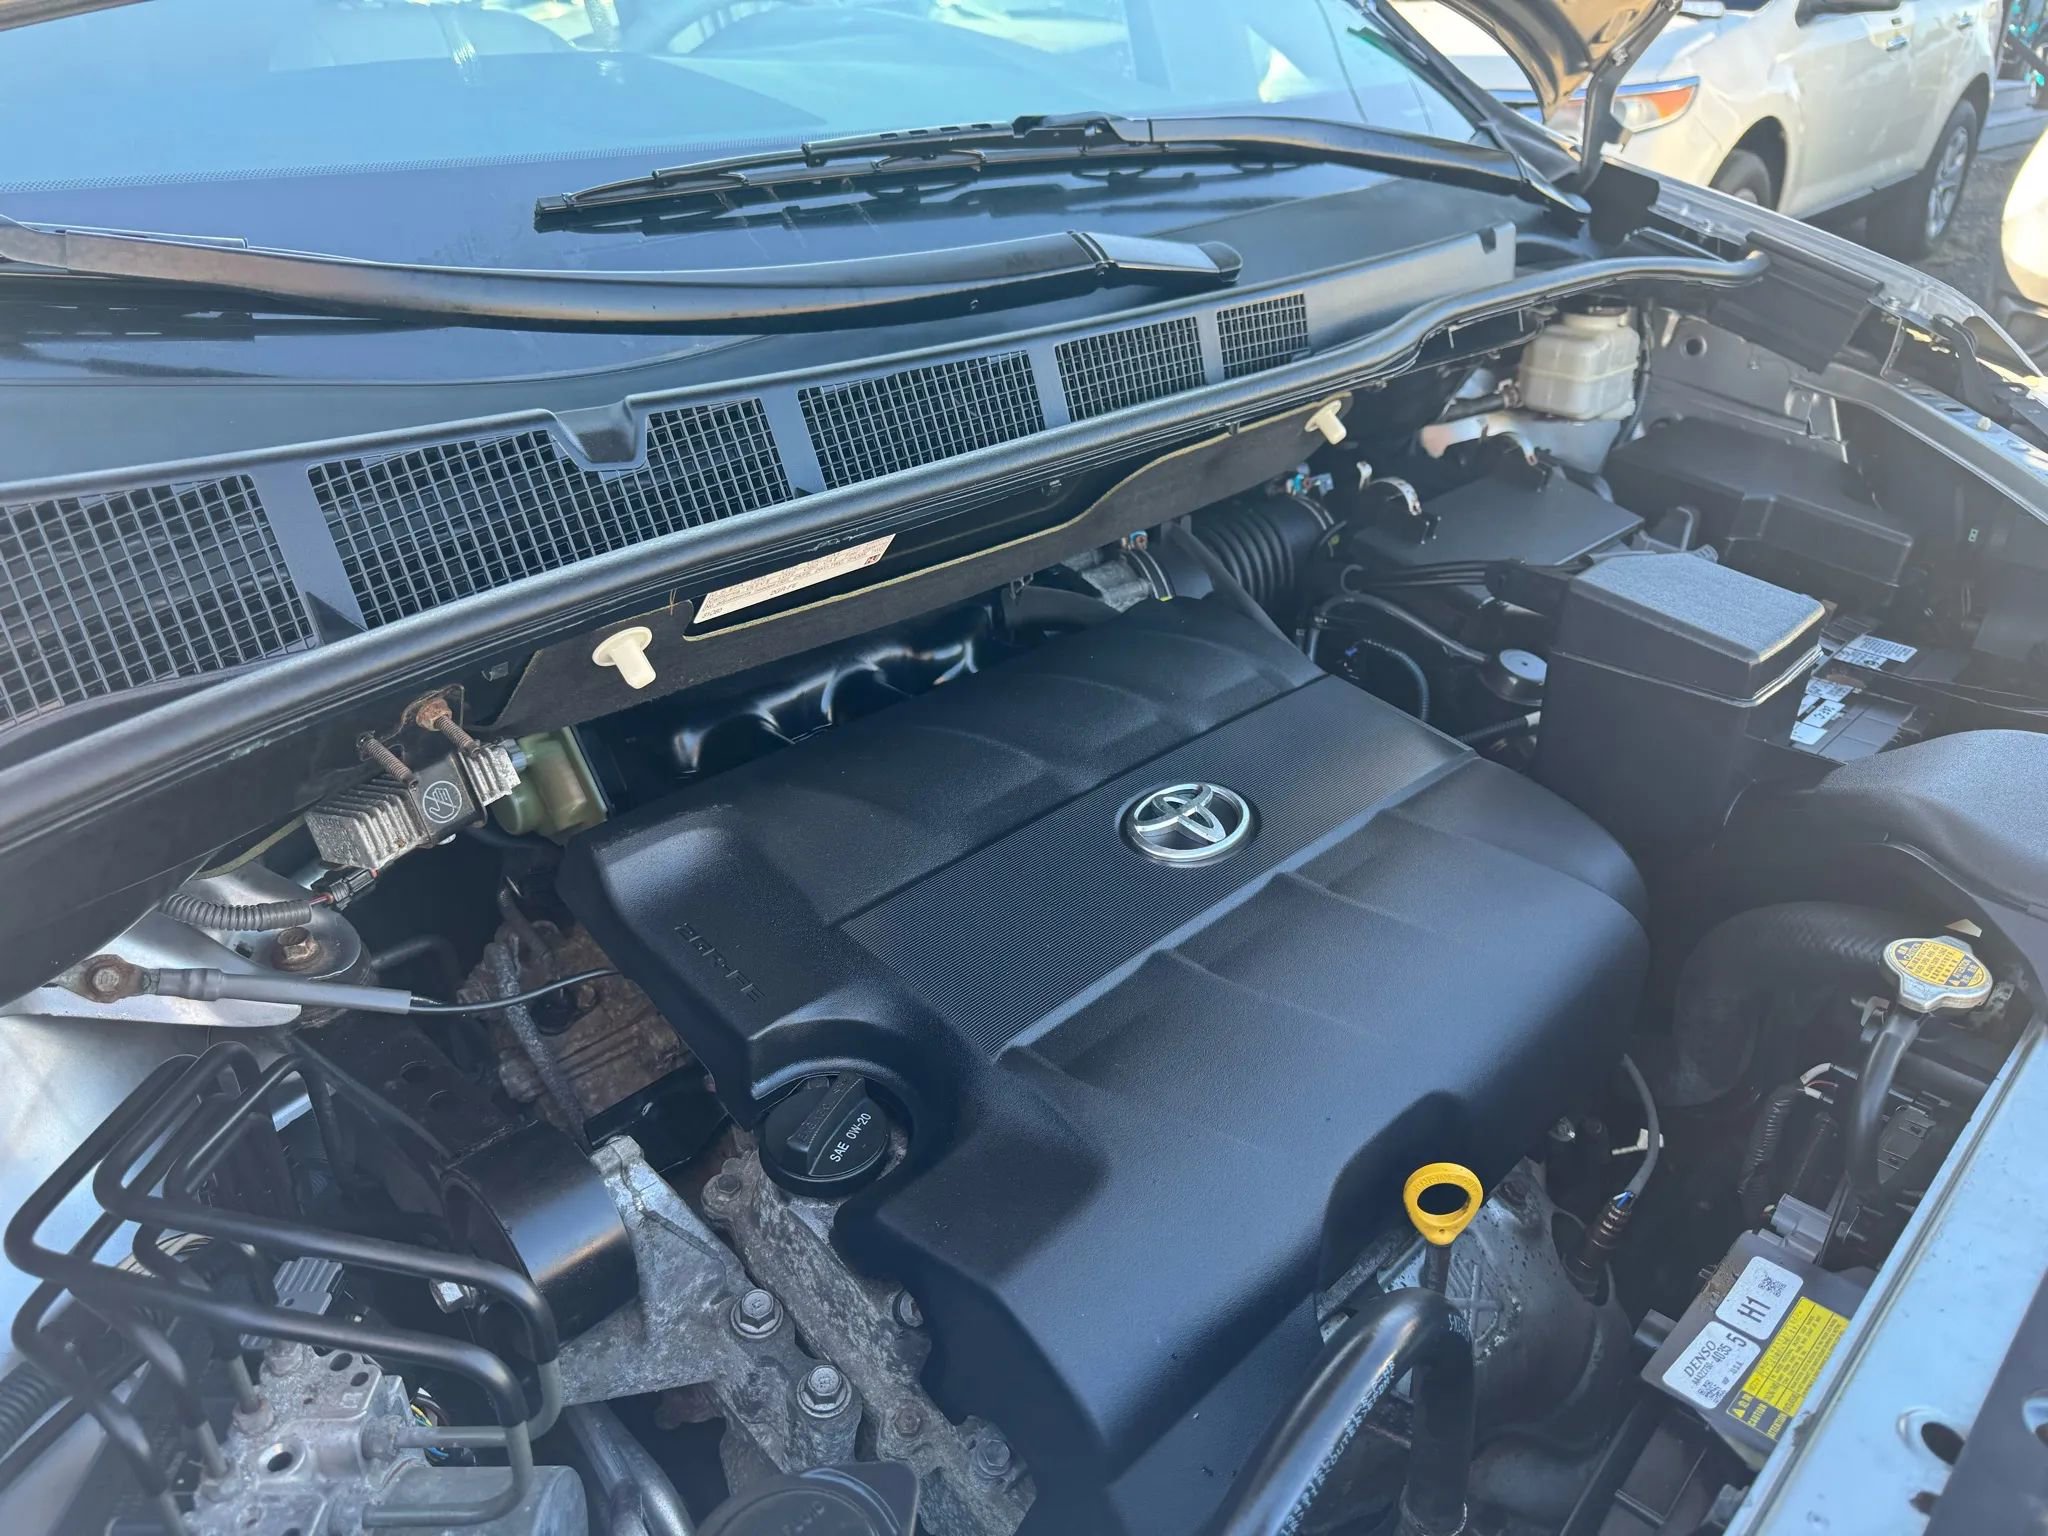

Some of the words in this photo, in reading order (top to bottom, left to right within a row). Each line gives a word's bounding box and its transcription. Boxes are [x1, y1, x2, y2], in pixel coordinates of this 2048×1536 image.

[829, 1141, 850, 1162] SAE
[845, 1112, 872, 1140] 0W-20
[1737, 1295, 1771, 1323] H1
[1726, 1332, 1747, 1348] 5
[1683, 1340, 1717, 1377] DENSO
